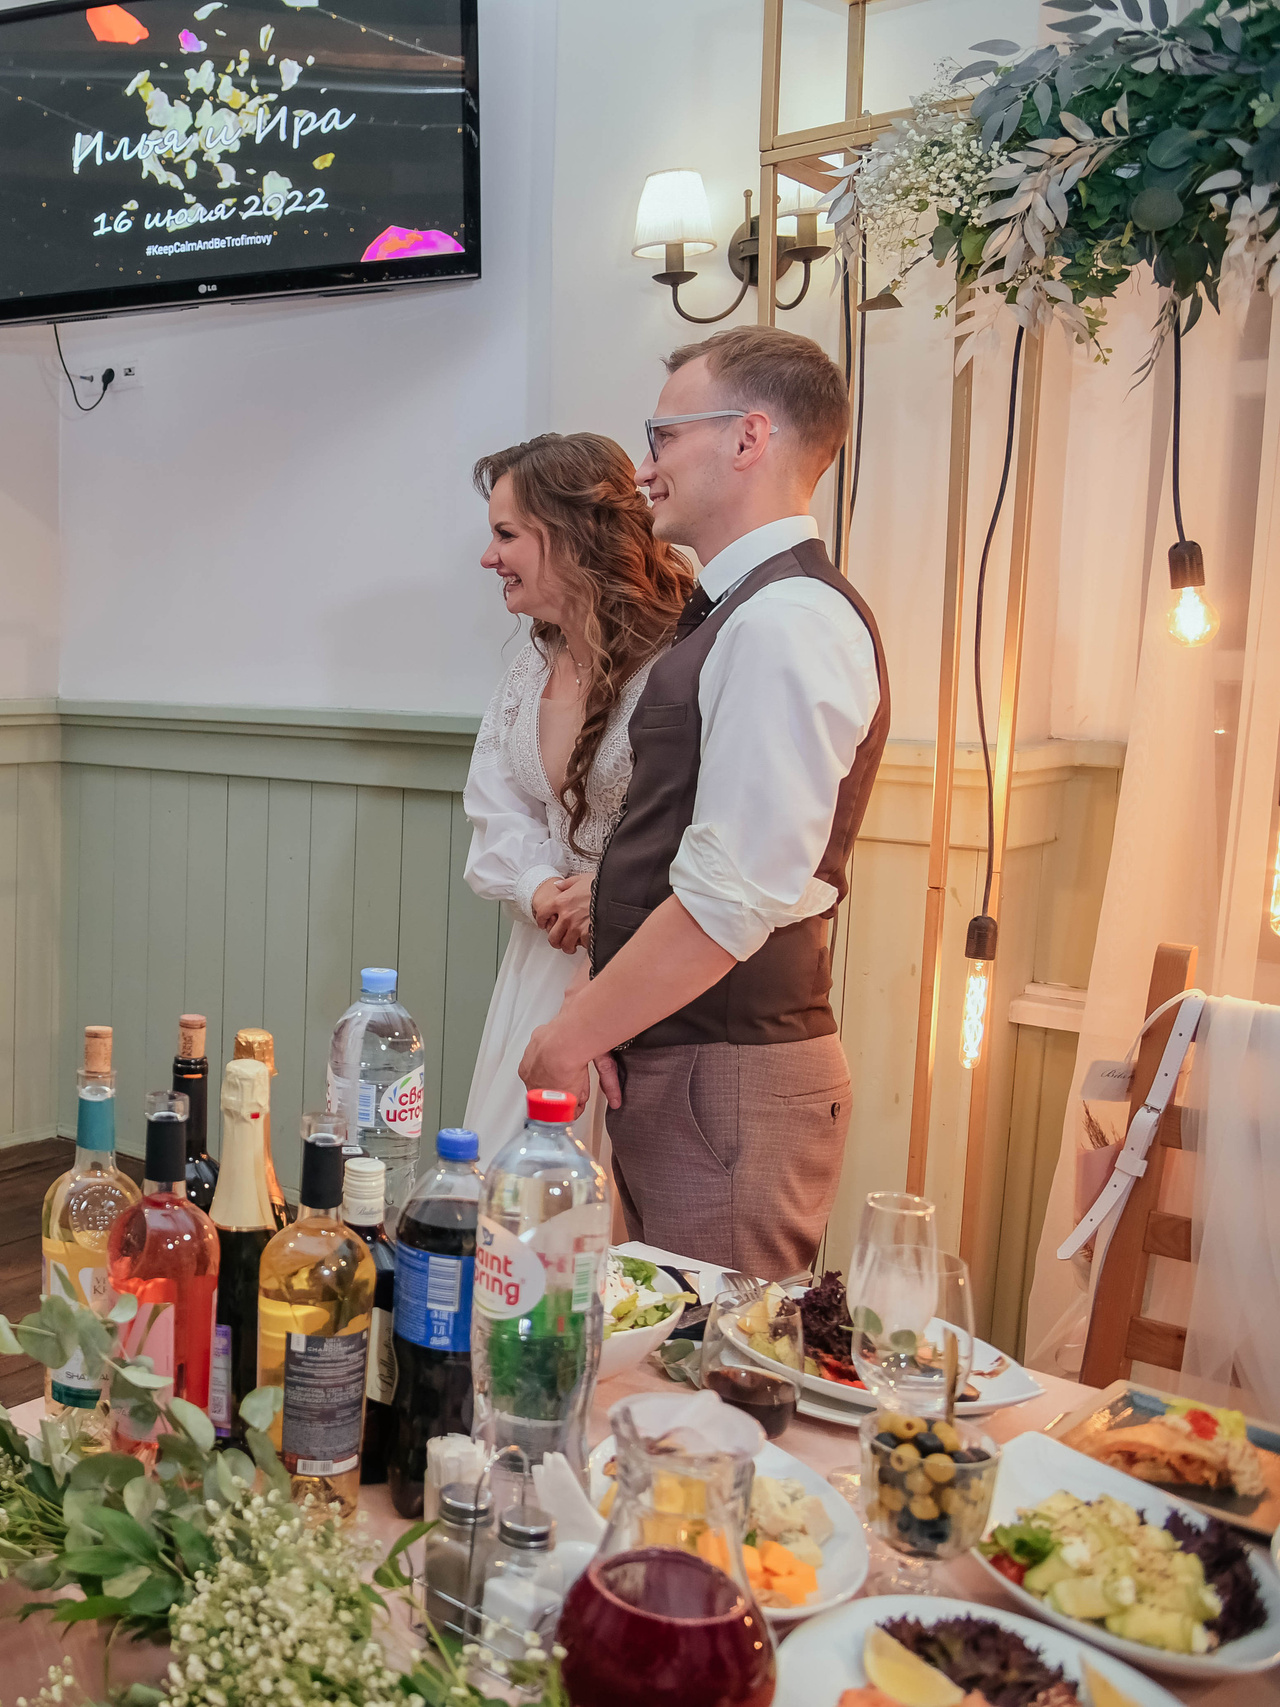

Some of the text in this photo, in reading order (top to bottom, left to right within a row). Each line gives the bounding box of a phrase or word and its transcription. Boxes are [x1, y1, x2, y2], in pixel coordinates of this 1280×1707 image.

[71, 105, 357, 168] Илья и Ира
[92, 187, 329, 236] 16 июля 2022
[145, 233, 273, 257] #KeepCalmAndBeTrofimovy
